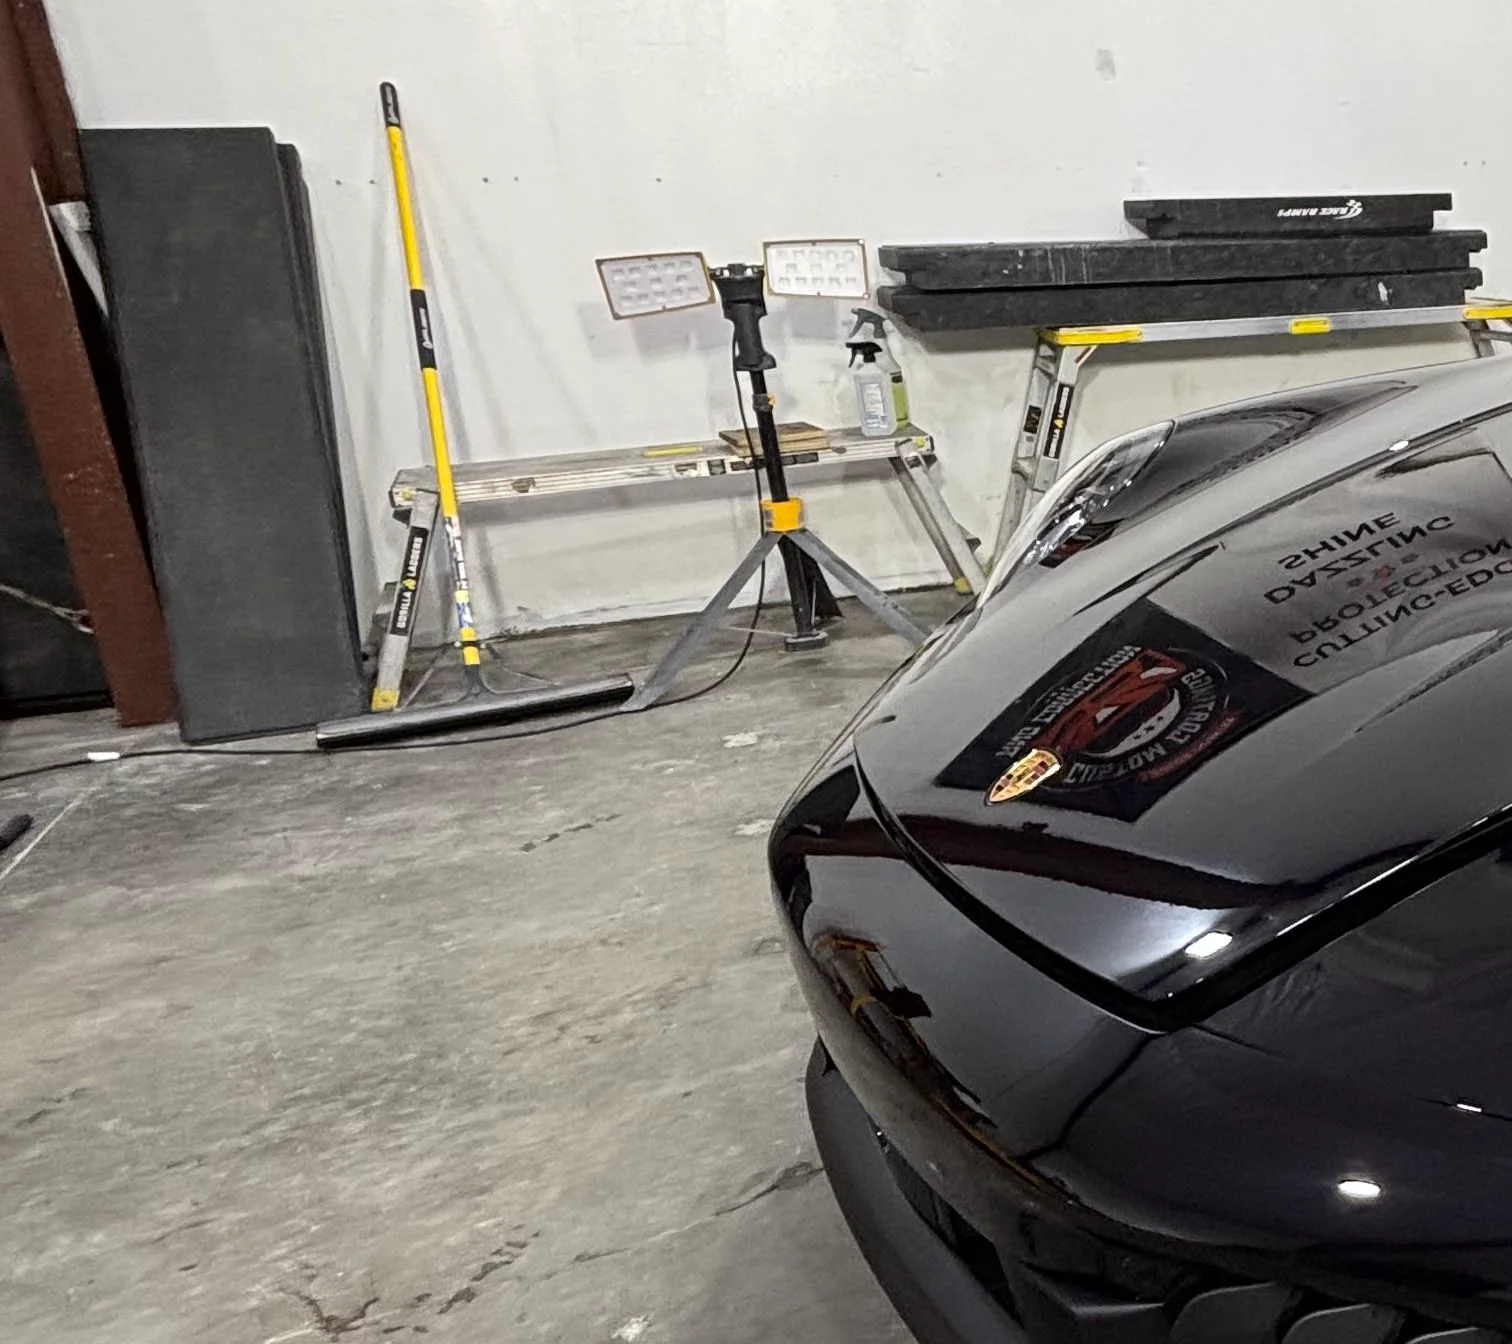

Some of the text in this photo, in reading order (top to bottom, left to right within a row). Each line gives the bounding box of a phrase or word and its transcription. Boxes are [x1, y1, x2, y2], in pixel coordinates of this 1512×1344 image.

[1276, 207, 1349, 217] RACE RAMPS
[397, 537, 423, 628] GORILLA LADDERS
